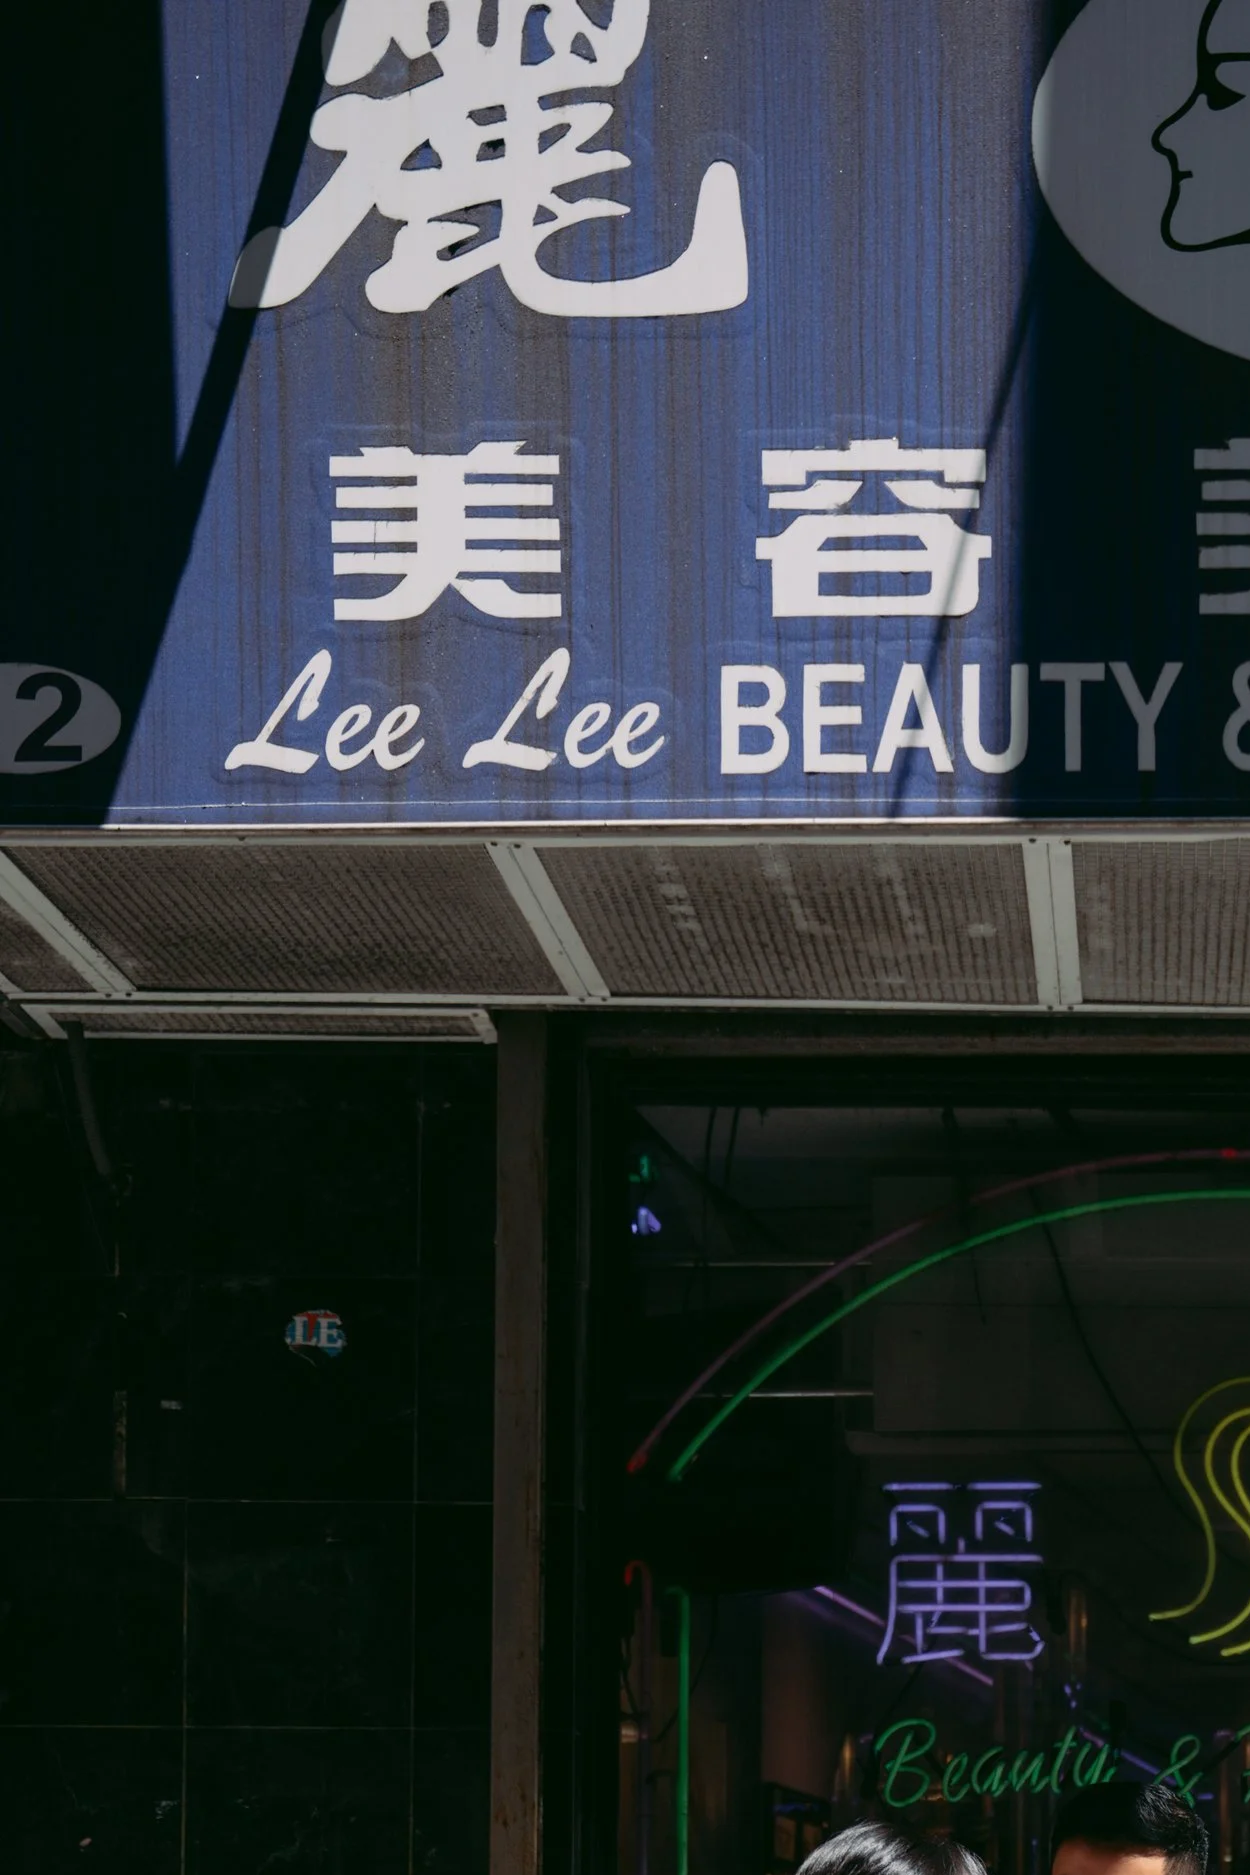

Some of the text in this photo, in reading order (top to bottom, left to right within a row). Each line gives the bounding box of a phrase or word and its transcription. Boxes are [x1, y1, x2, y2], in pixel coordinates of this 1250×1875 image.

[14, 672, 83, 762] 2
[225, 649, 424, 773] Lee
[463, 647, 666, 772] Lee
[721, 661, 1184, 774] BEAUTY
[877, 1481, 1046, 1665] 麗
